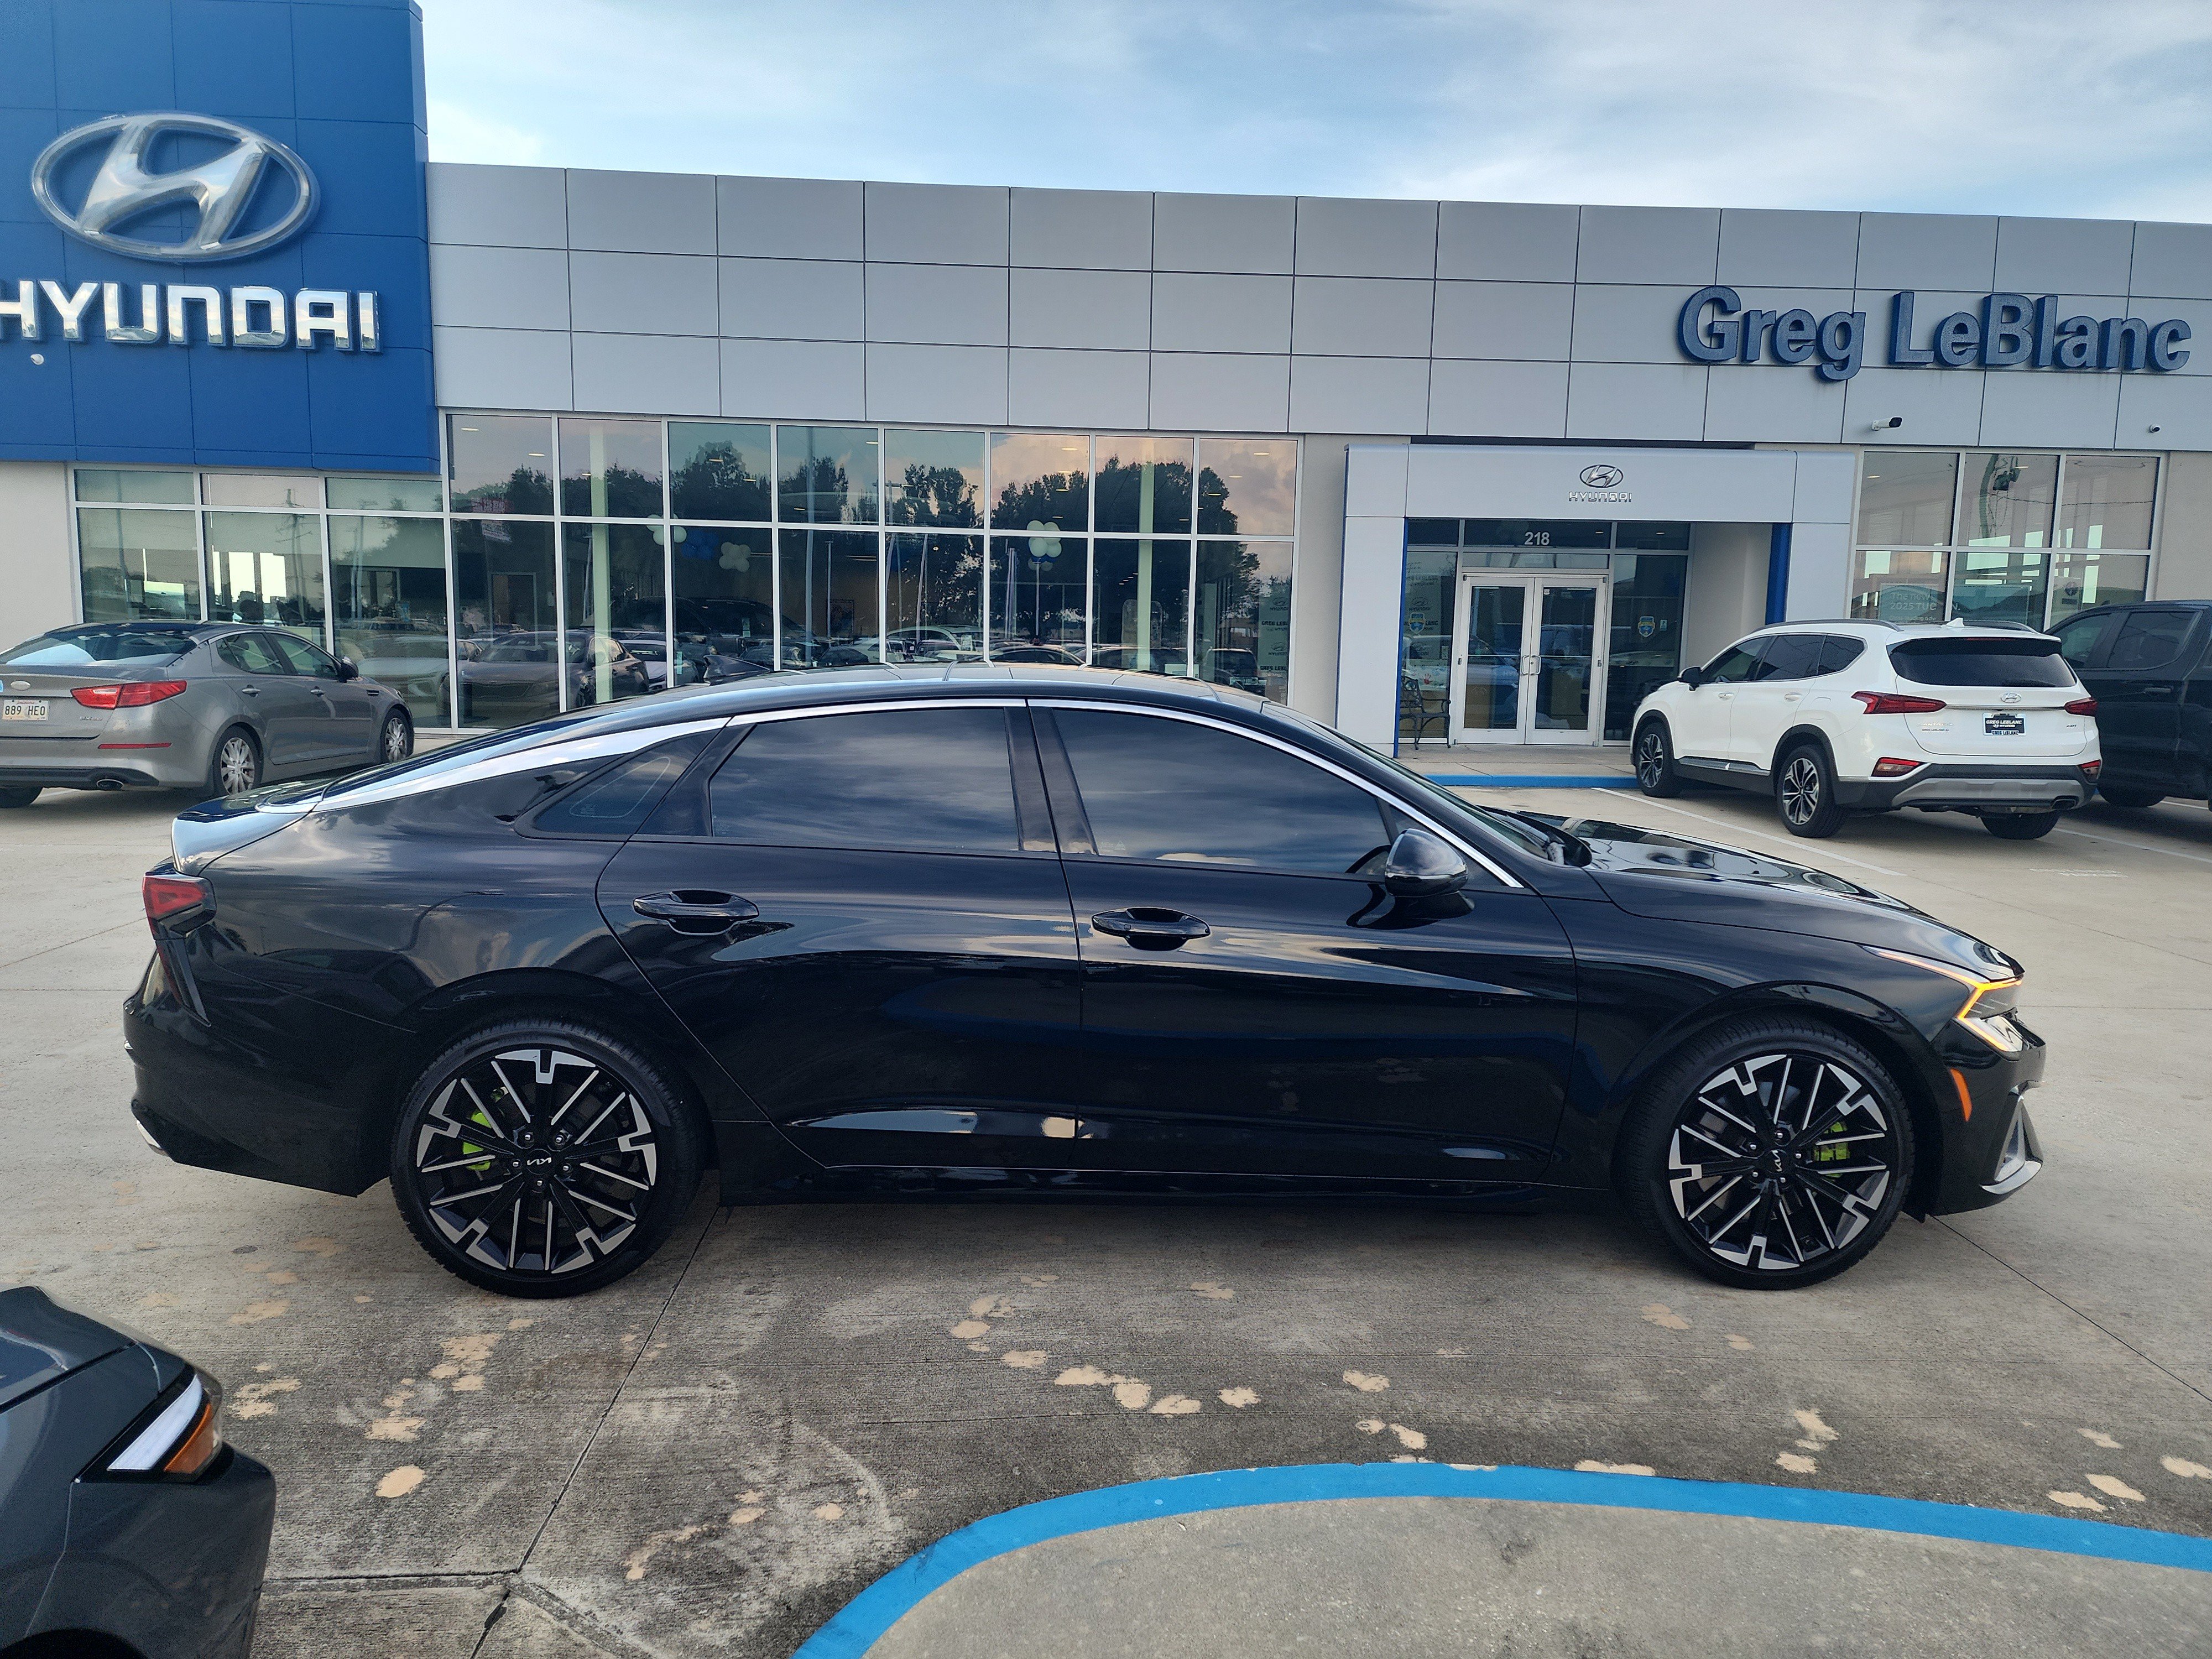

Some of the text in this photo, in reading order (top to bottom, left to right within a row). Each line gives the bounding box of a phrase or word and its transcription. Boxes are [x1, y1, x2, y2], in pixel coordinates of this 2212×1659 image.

[1678, 286, 2192, 382] Greg LeBlanc
[1568, 491, 1632, 503] HYUNDAI
[1524, 531, 1550, 546] 218
[1890, 602, 1914, 611] 2025
[5, 705, 22, 715] 889
